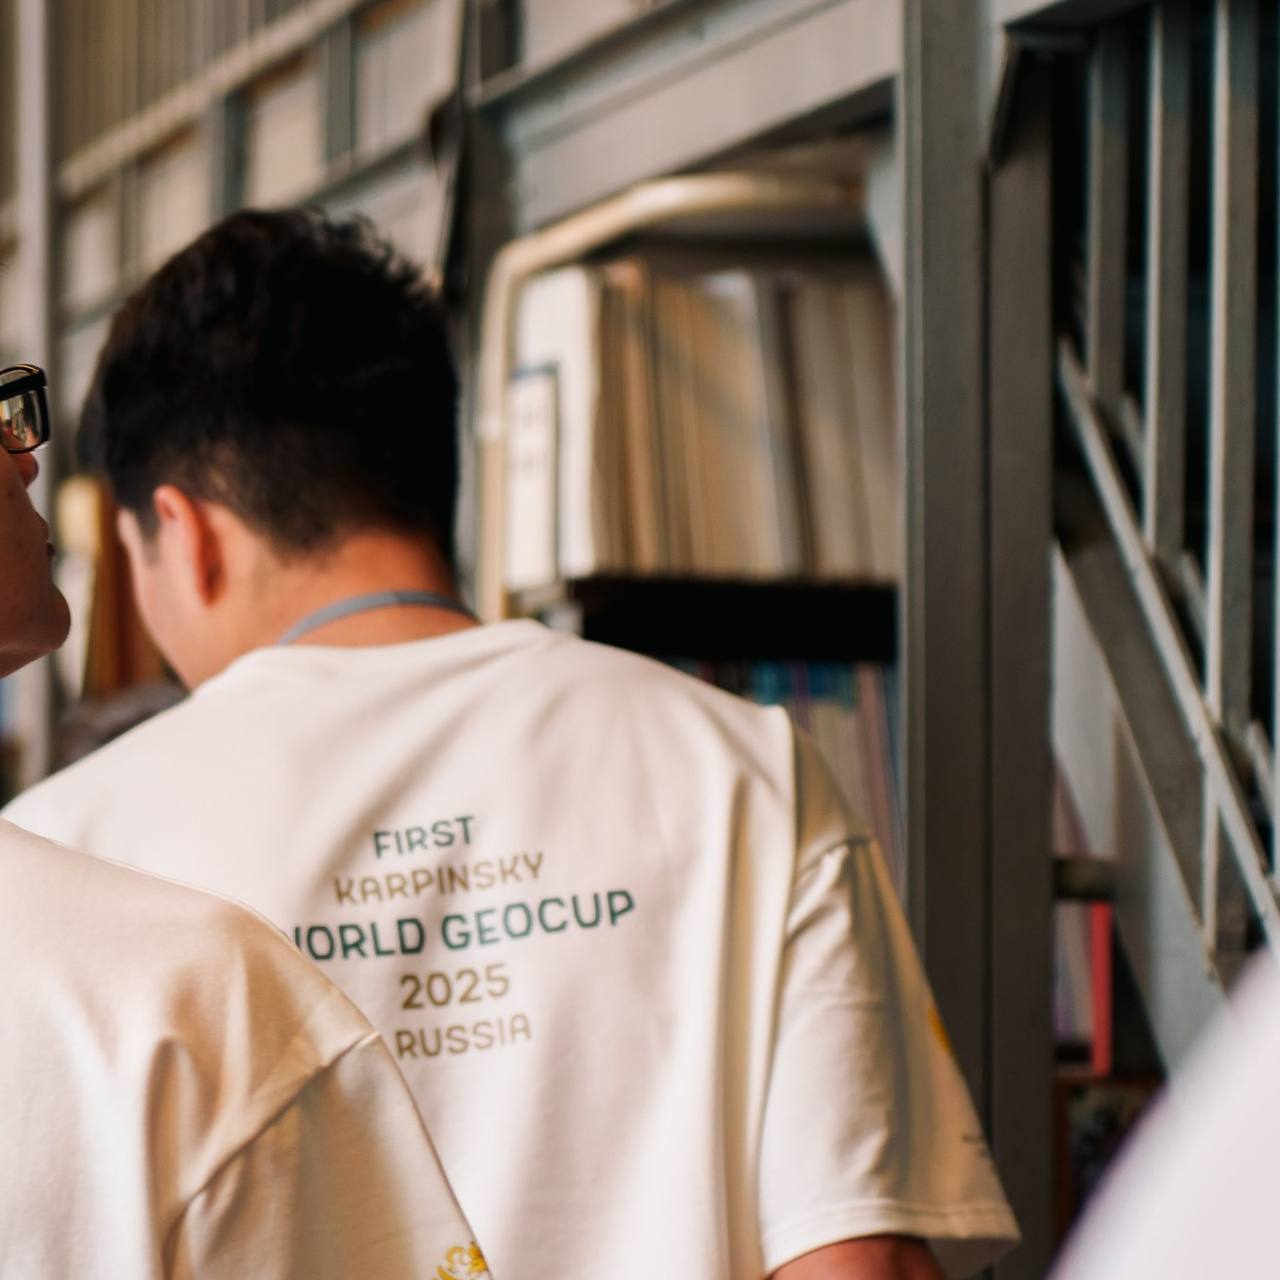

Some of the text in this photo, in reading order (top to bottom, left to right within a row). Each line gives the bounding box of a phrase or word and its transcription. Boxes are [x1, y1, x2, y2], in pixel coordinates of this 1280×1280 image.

[373, 816, 475, 858] FIRST
[334, 851, 543, 905] KARPINSKY
[441, 890, 635, 950] GEOCUP
[399, 964, 510, 1010] 2025
[395, 1013, 532, 1059] RUSSIA
